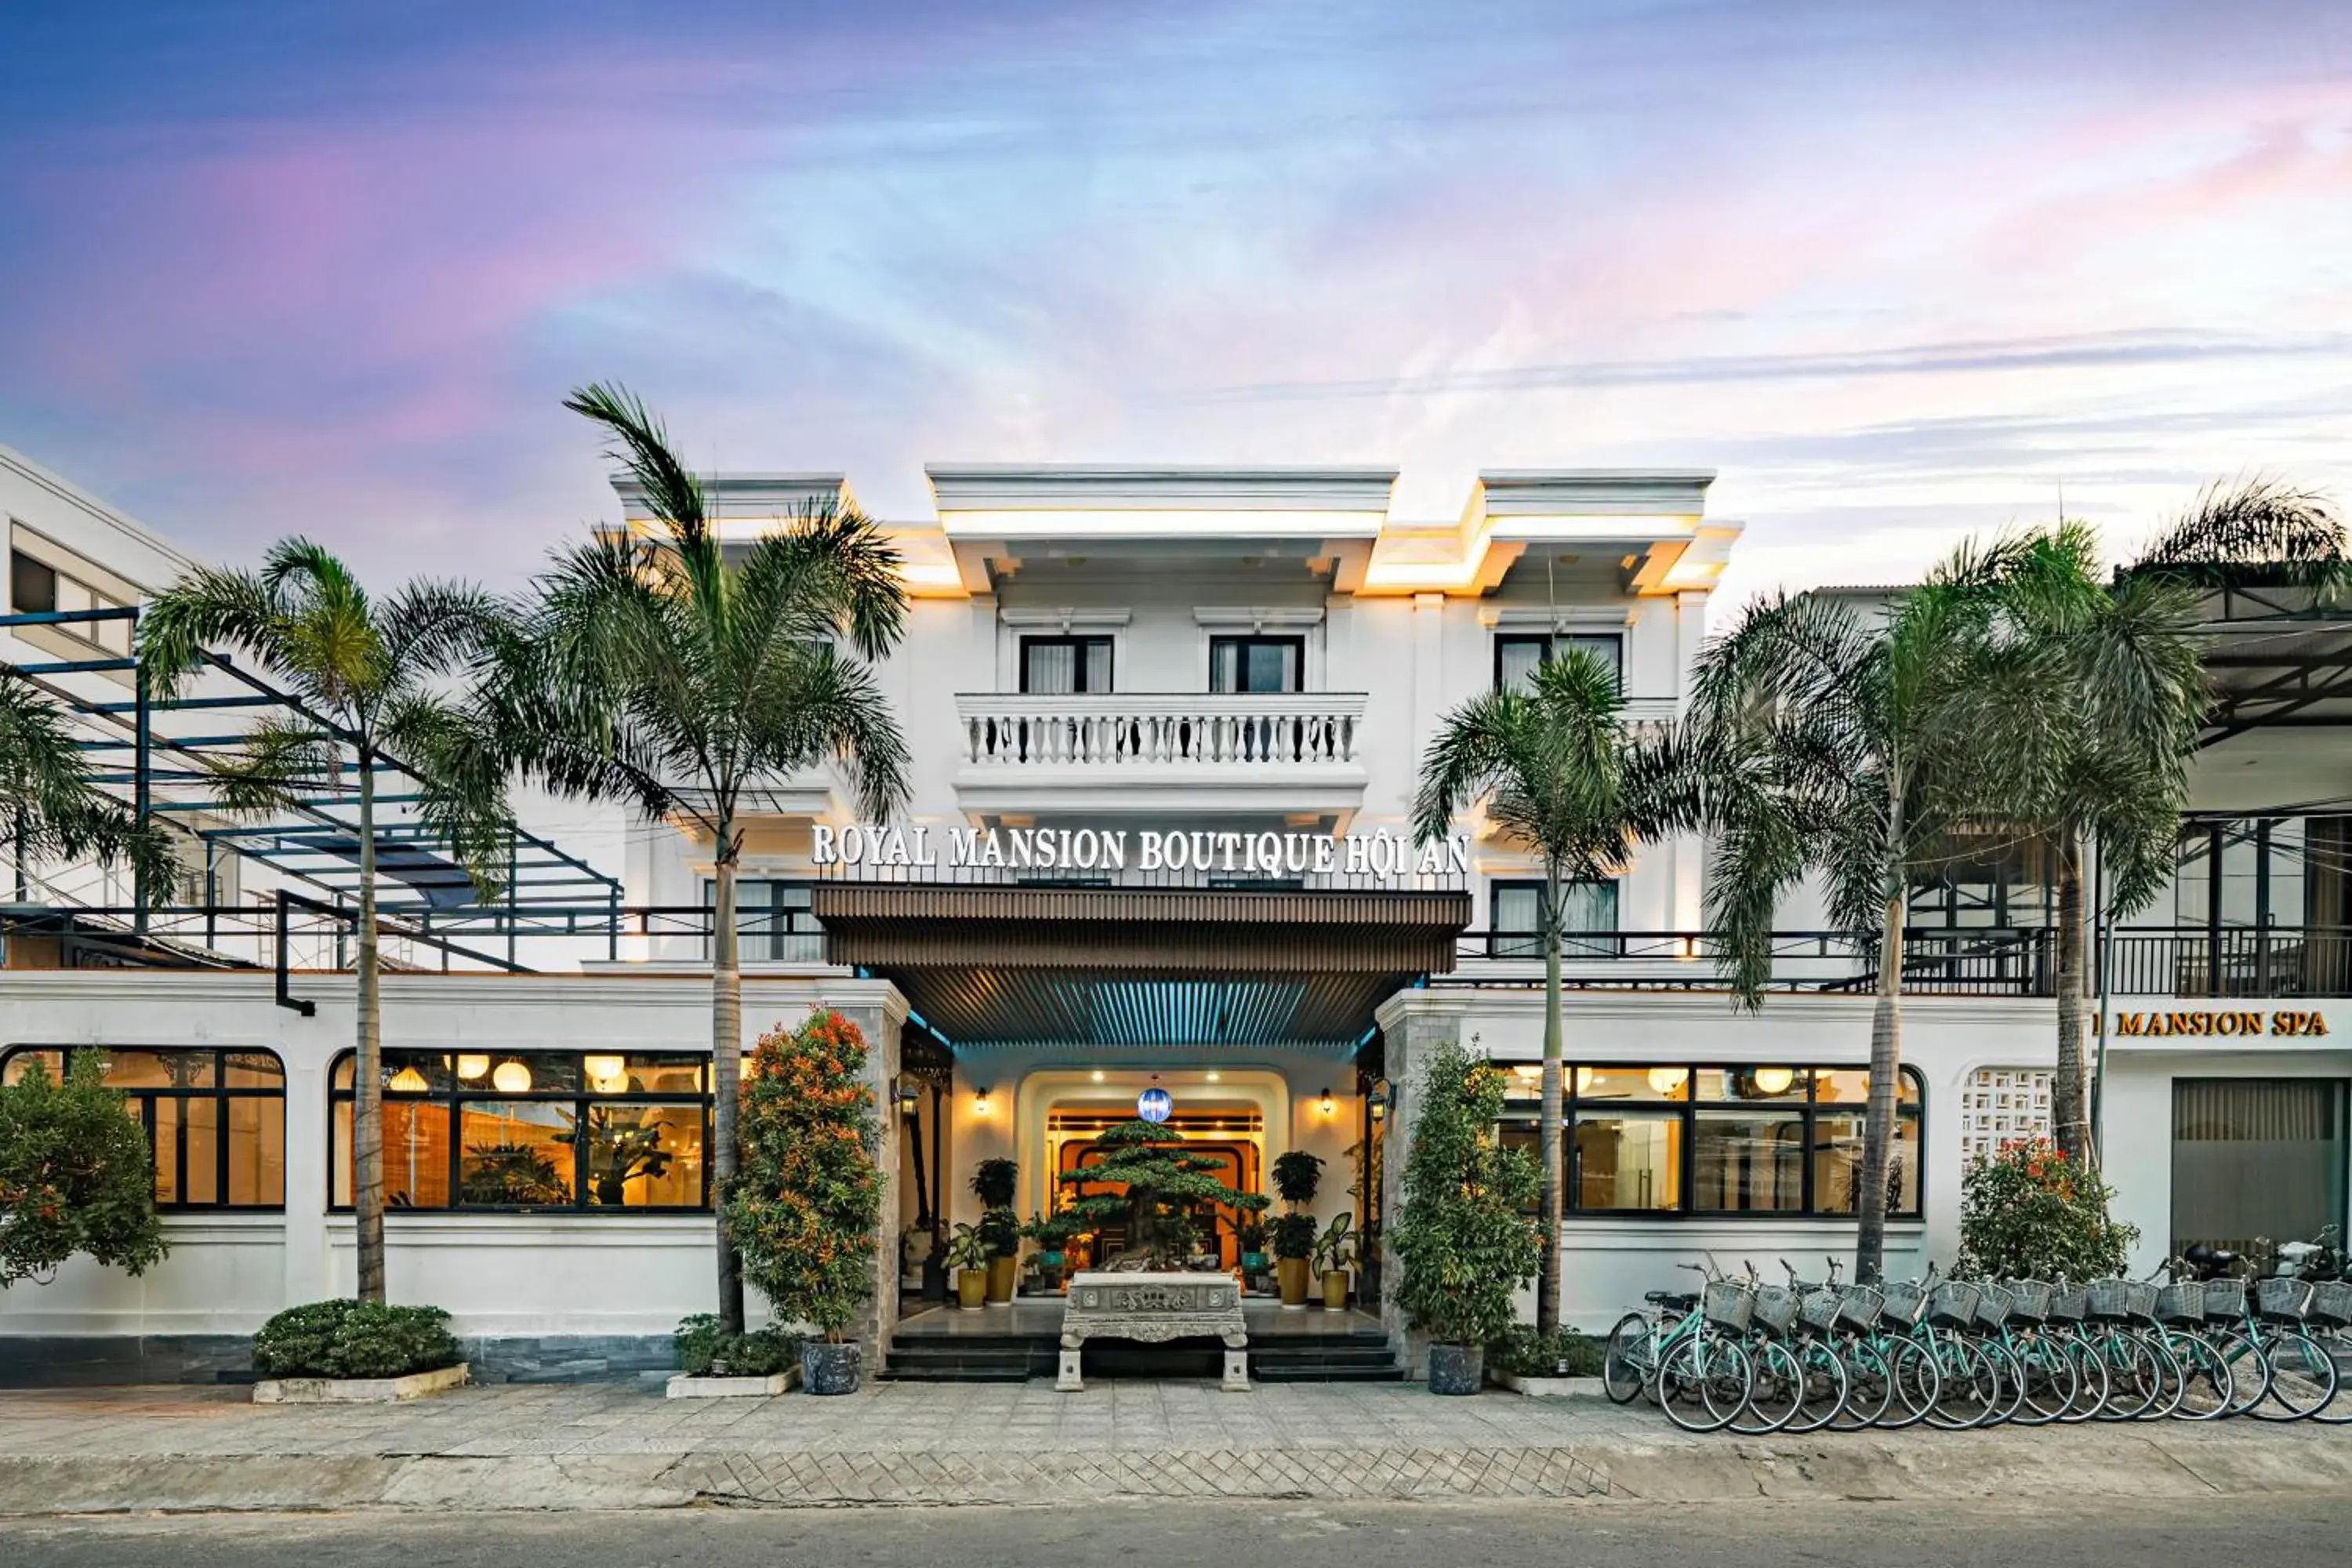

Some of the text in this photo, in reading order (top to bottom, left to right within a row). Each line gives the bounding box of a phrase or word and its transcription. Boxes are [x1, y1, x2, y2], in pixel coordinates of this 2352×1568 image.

[811, 824, 1471, 881] ROYAL MANSION BOUTIQUE HỘI AN
[2116, 1011, 2264, 1036] MANSION
[2271, 1011, 2330, 1036] SPA
